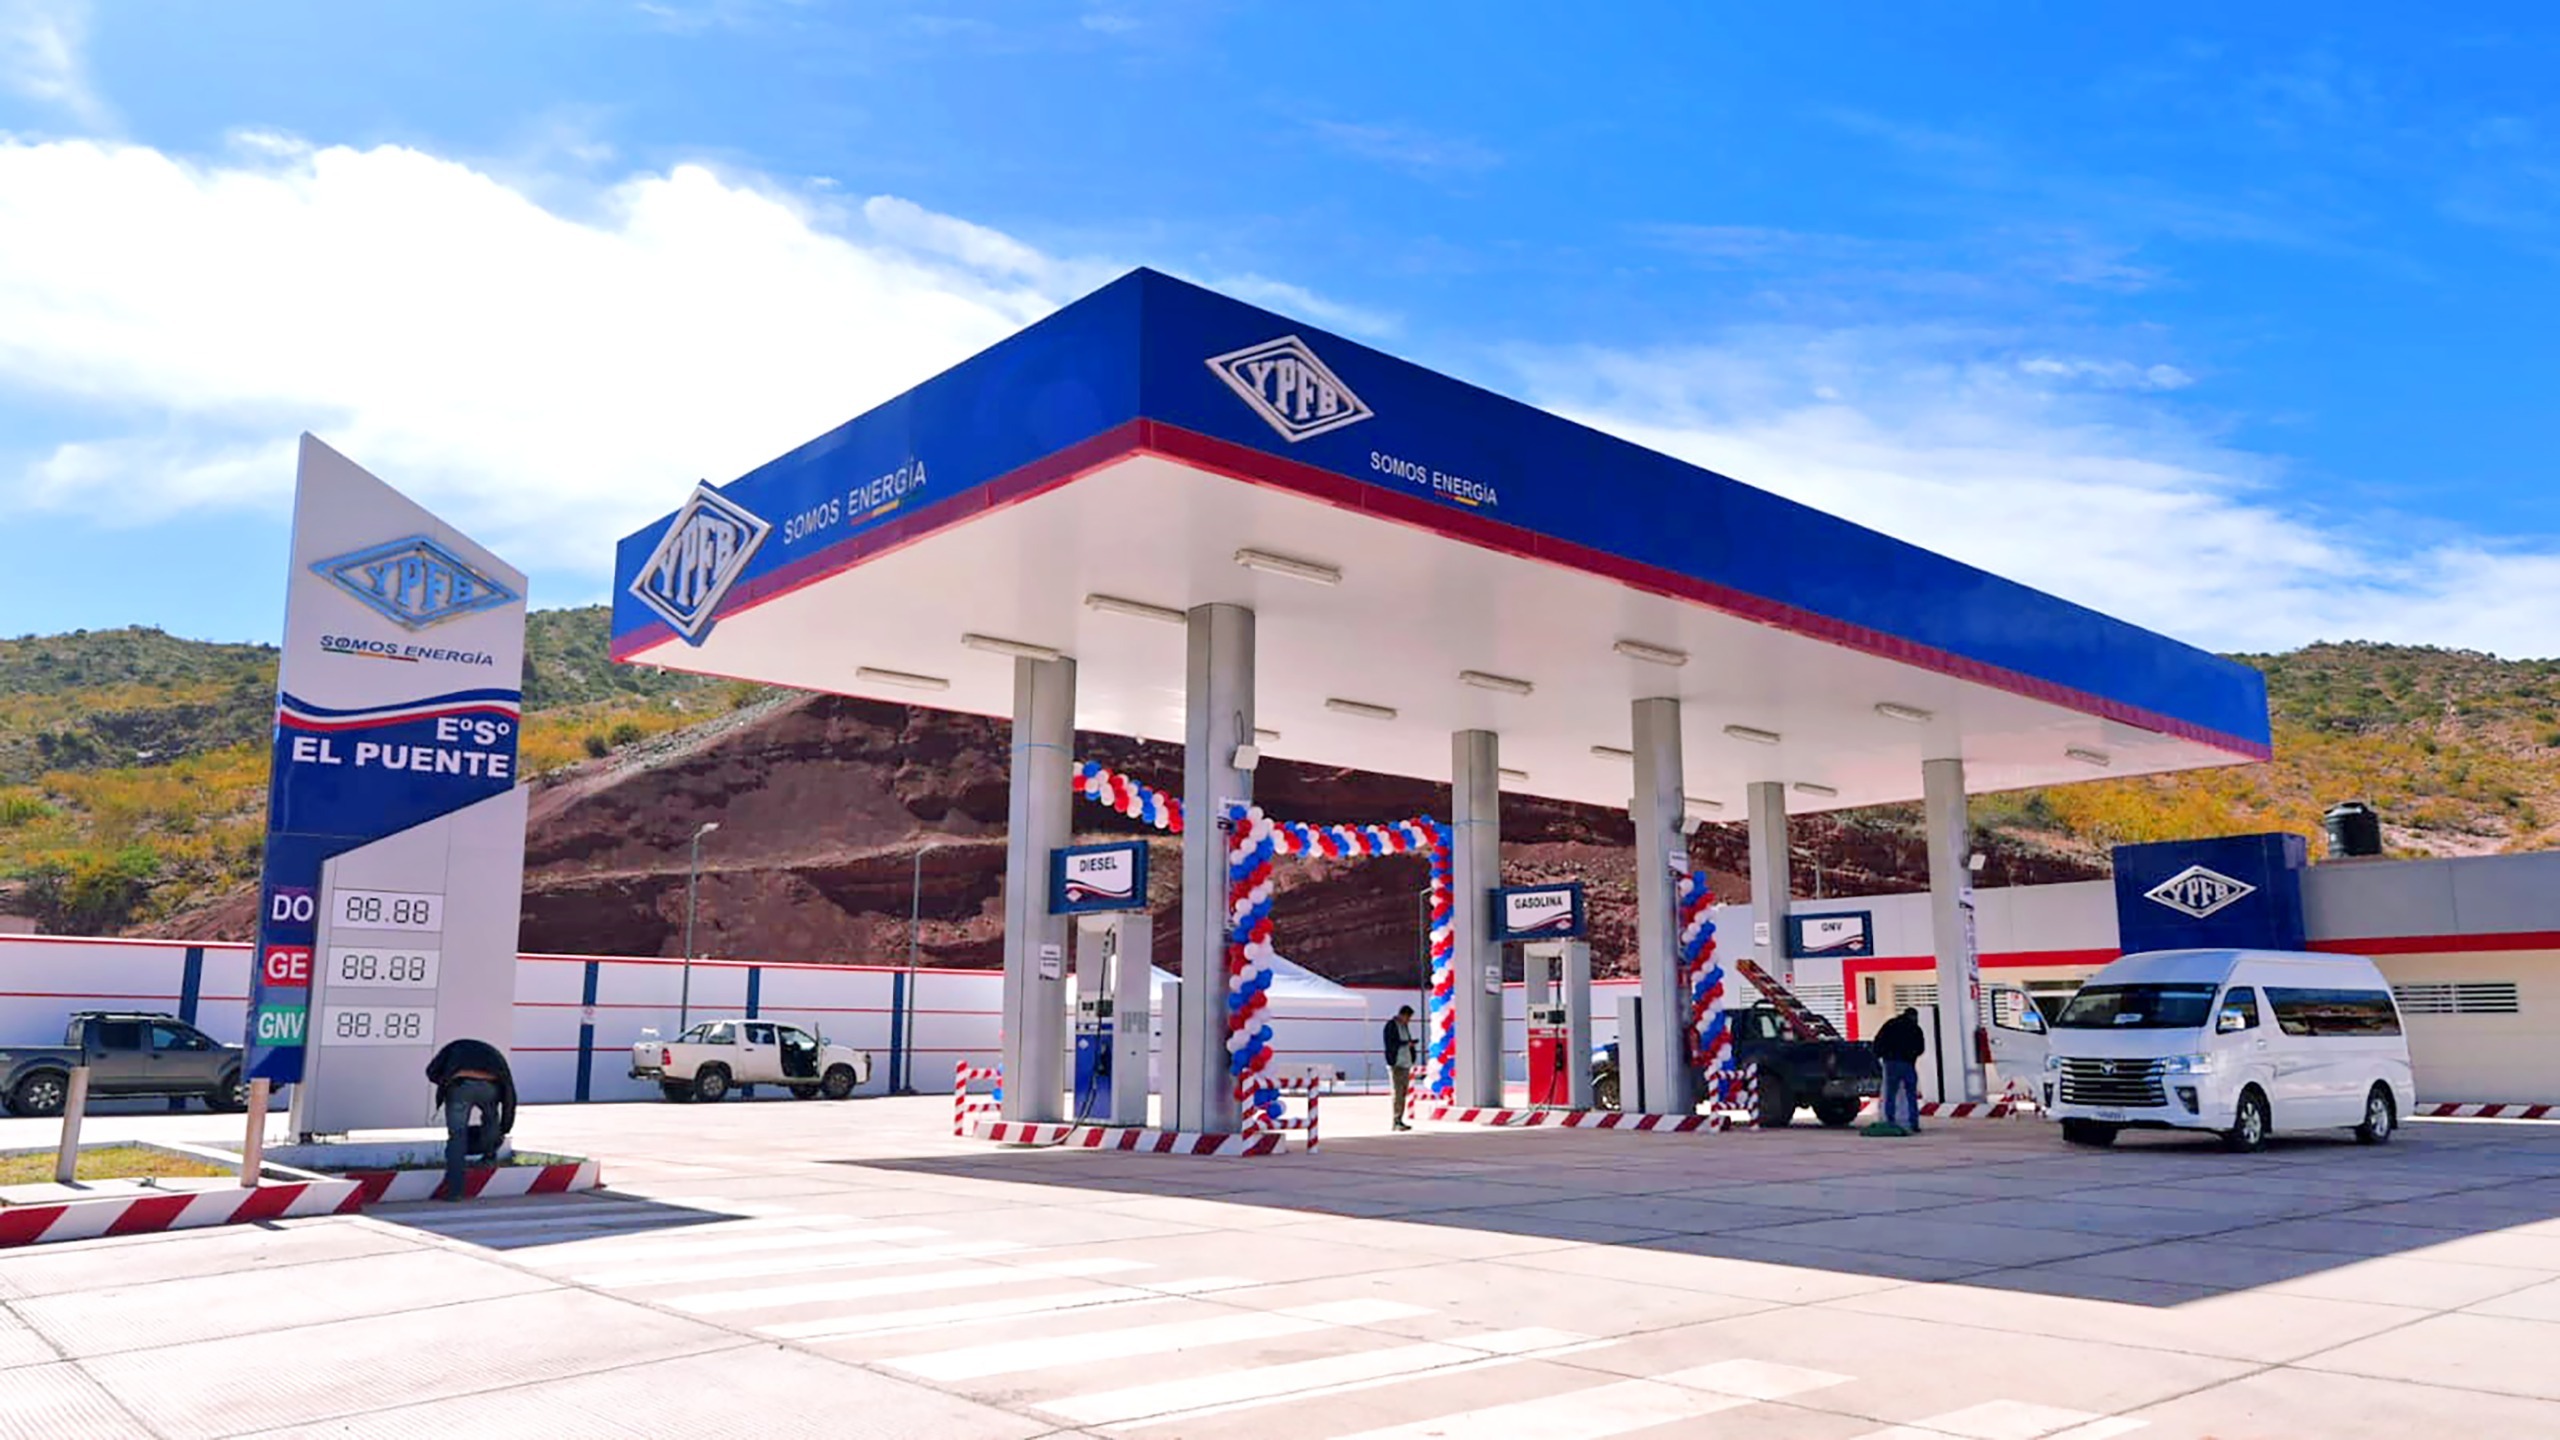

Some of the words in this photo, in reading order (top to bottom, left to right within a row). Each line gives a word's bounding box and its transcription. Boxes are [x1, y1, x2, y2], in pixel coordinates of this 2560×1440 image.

[1246, 358, 1338, 421] YPFB
[1370, 451, 1427, 485] SOMOS
[1433, 471, 1498, 506] ENERGÍA
[783, 498, 840, 545] SOMOS
[657, 513, 739, 608] YPFB
[364, 556, 475, 611] YPFB
[320, 634, 398, 656] SOMOS
[404, 645, 494, 667] ENERGÍA
[292, 736, 342, 765] EL
[355, 741, 510, 779] PUENTE
[1079, 856, 1118, 872] DIESEL
[1514, 896, 1563, 909] GASOLINA
[2168, 877, 2228, 907] YPFB
[272, 894, 314, 922] DO
[346, 896, 429, 924] 88.88
[1821, 922, 1843, 932] GNV
[267, 952, 308, 980] GE
[342, 955, 425, 981] 88.88
[258, 1012, 305, 1038] GNV
[337, 1012, 420, 1038] 88.88
